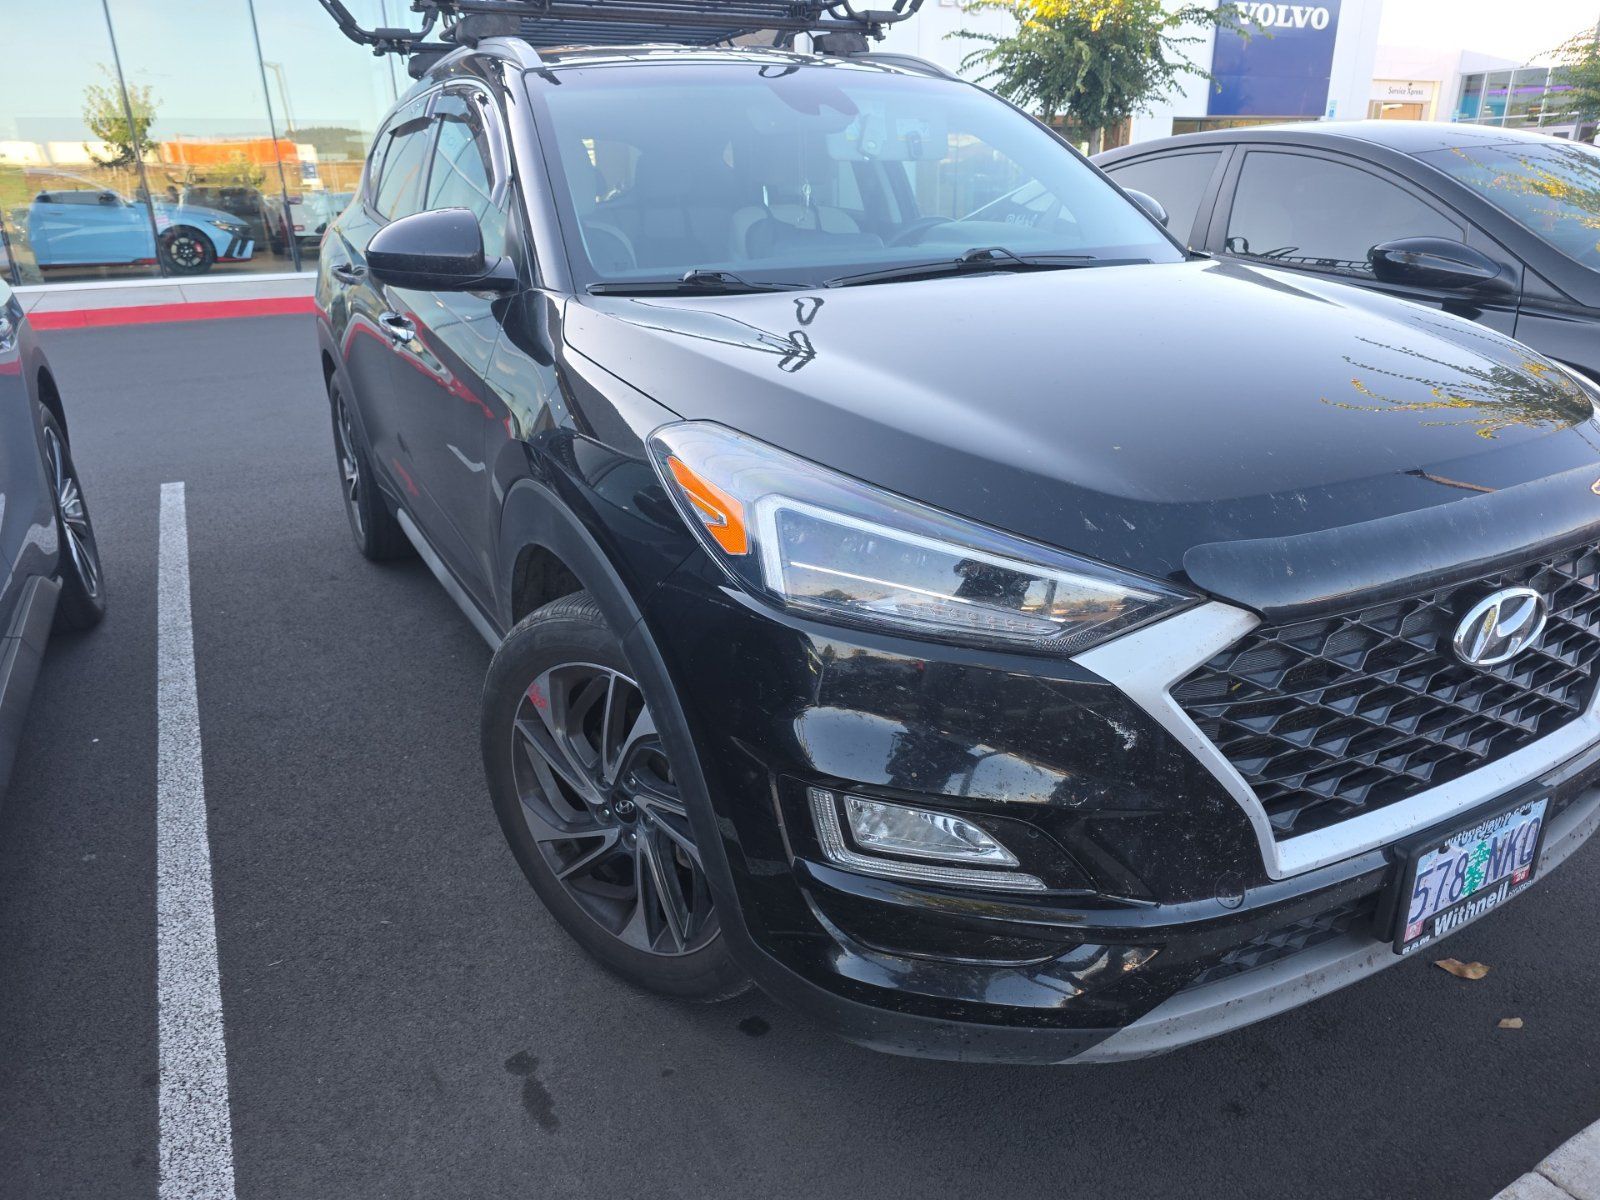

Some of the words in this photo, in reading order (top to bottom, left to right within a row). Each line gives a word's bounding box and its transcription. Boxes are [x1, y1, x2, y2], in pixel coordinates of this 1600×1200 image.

[1233, 1, 1330, 30] VOLVO
[1388, 86, 1406, 96] Service
[1408, 853, 1470, 924] 578
[1435, 881, 1508, 937] Withnell
